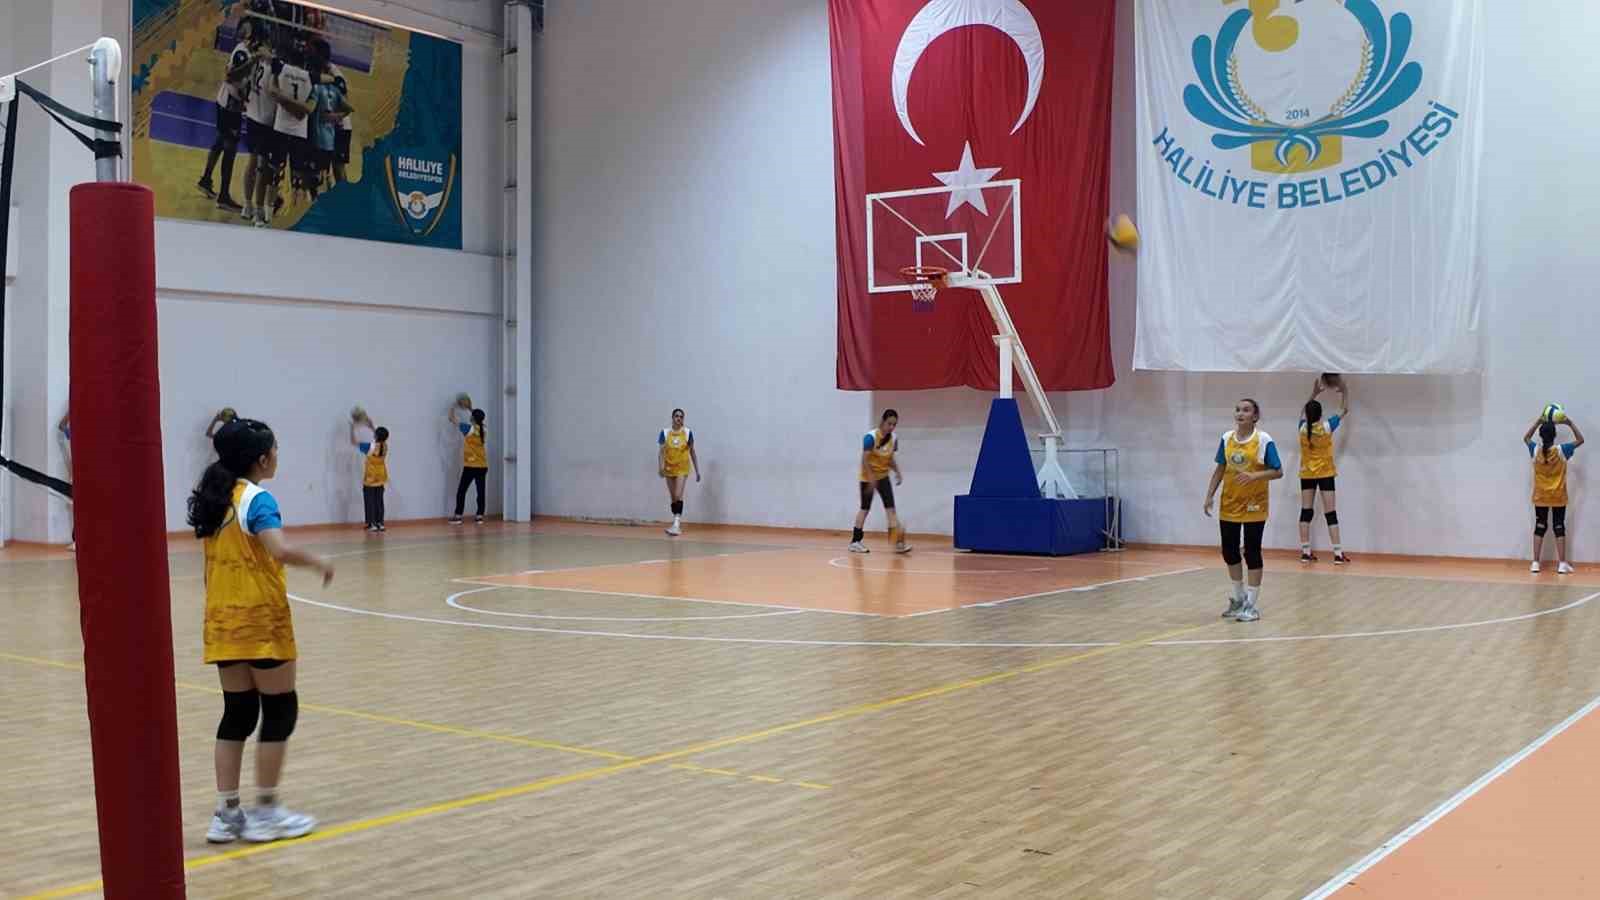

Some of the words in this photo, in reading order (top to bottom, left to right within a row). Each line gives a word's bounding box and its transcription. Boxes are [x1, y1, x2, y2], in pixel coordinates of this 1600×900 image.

[1286, 108, 1310, 120] 2014
[1153, 127, 1268, 208] HALİLİYE
[1277, 100, 1459, 209] BELEDİYESİ
